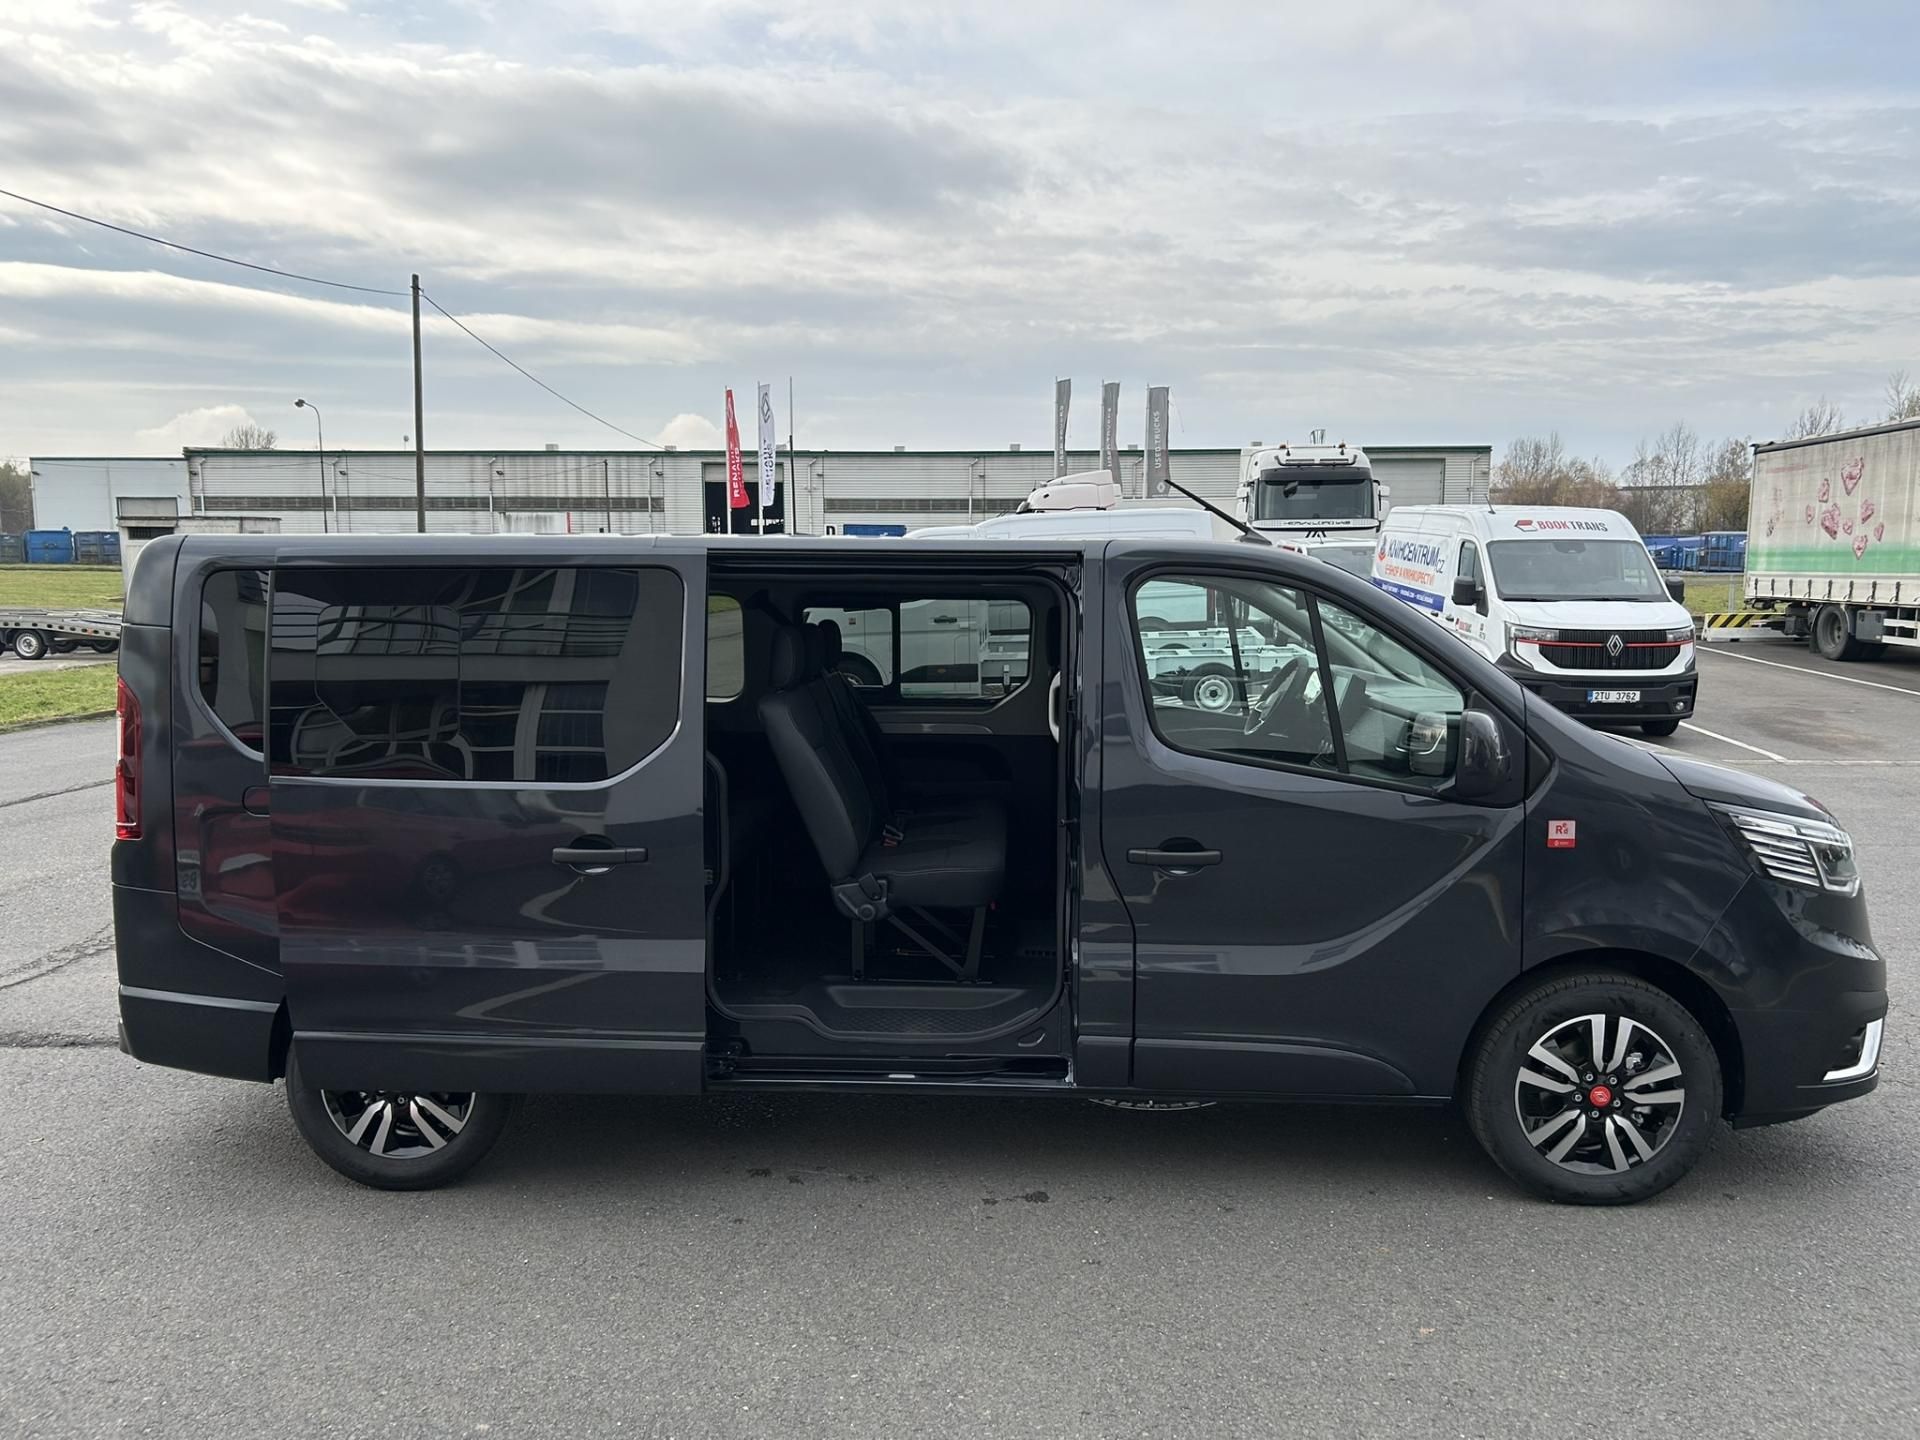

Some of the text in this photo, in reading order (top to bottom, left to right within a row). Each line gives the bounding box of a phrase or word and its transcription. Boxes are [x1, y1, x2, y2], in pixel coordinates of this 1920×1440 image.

[1153, 410, 1161, 445] TRUCKS
[1594, 691, 1636, 700] 2TU 3762
